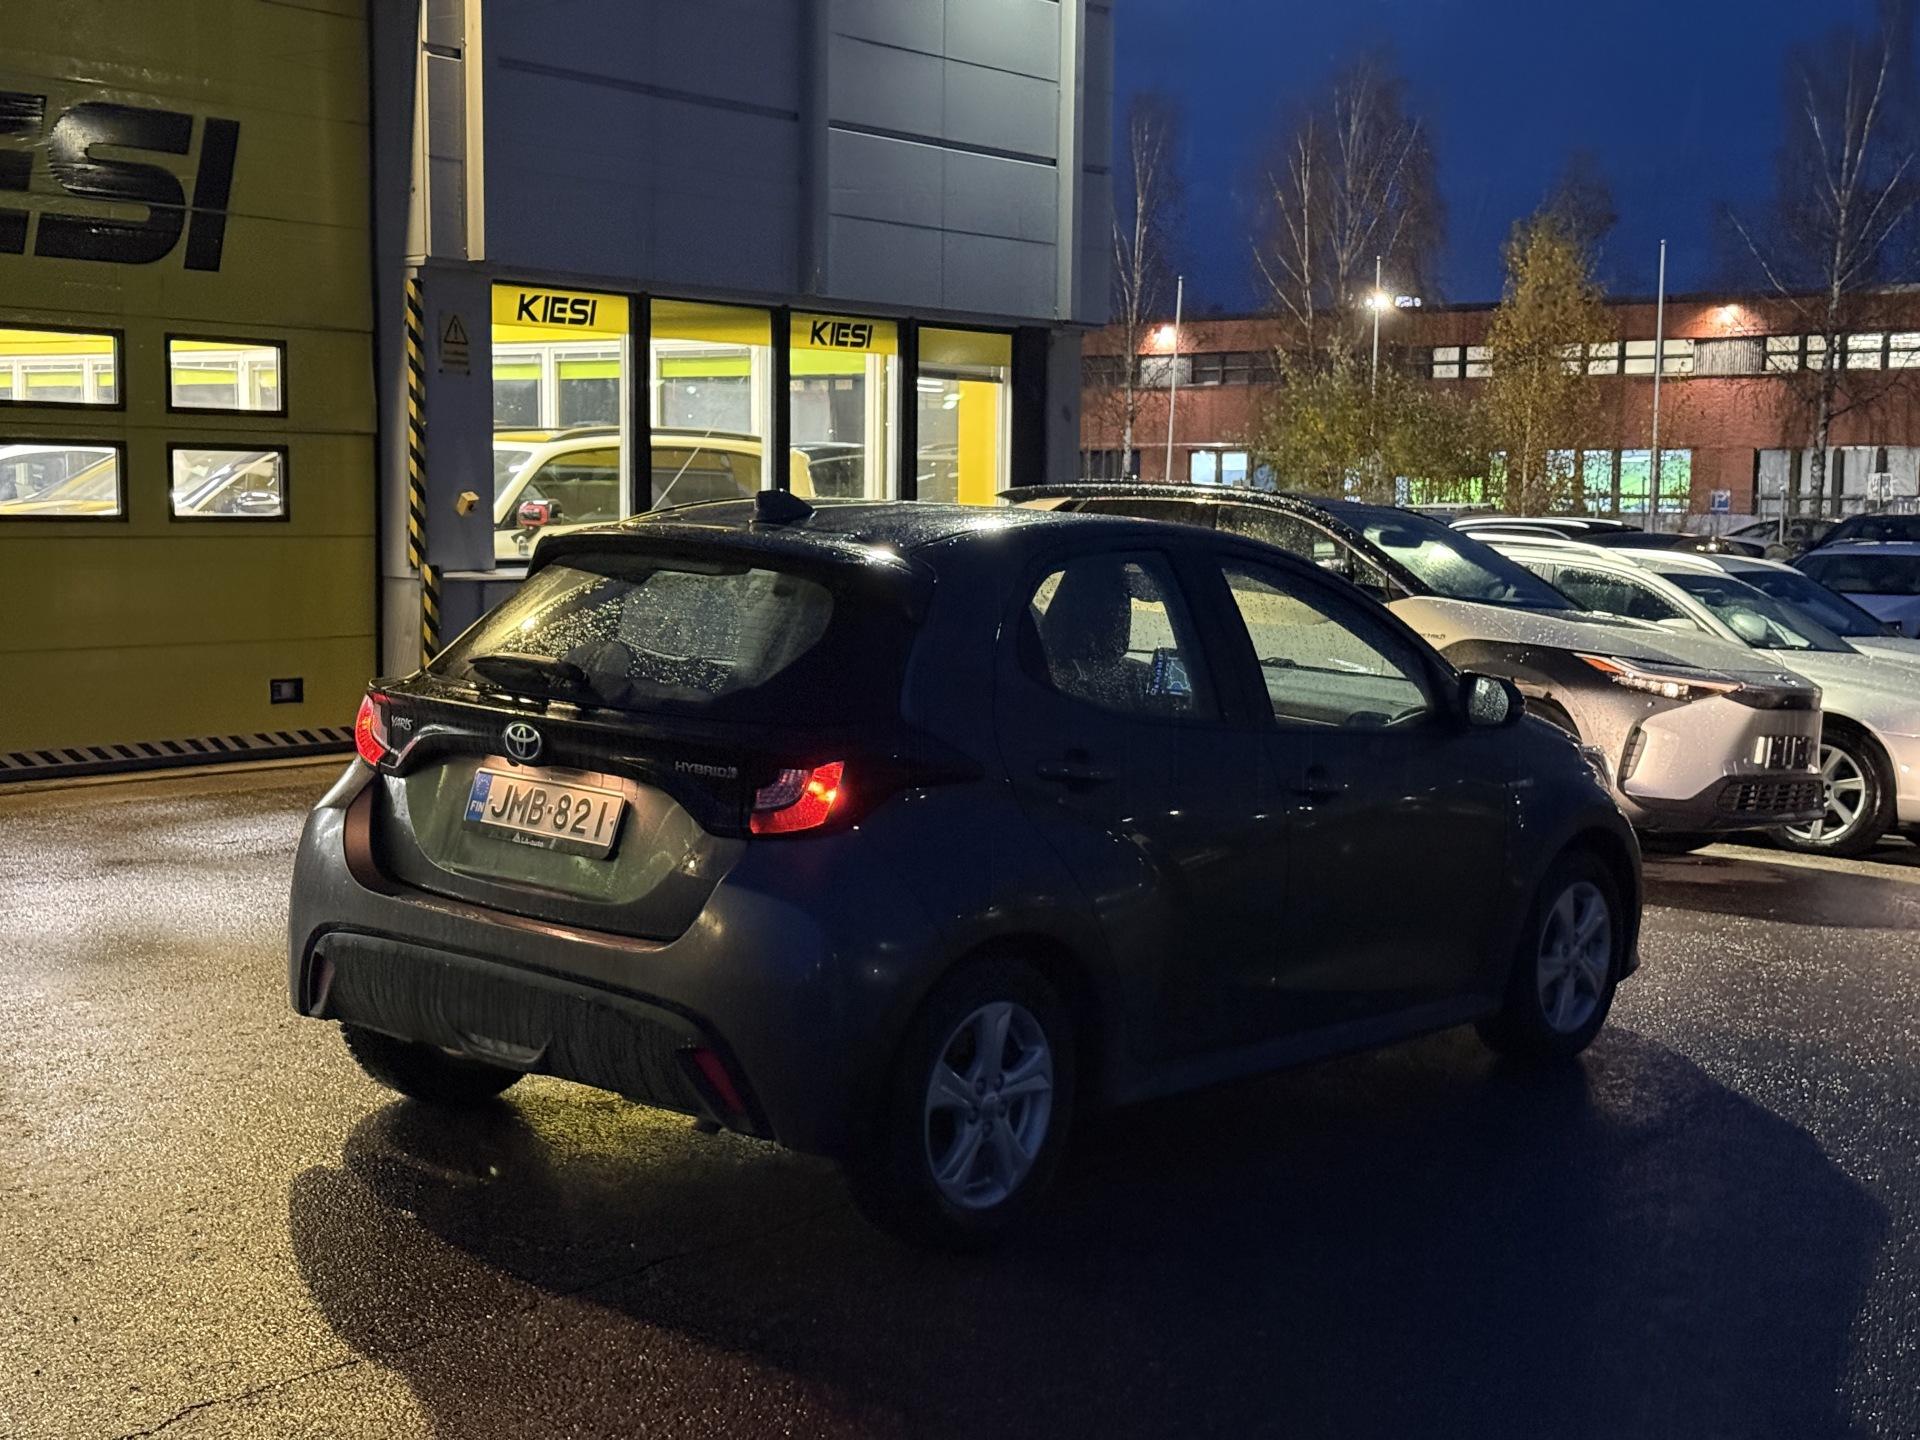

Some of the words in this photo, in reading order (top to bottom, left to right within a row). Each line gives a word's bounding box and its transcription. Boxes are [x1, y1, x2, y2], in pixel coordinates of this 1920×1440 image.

[517, 293, 597, 326] KIESI
[810, 321, 873, 349] KIESI
[391, 715, 413, 731] YARIS
[675, 760, 727, 778] HYBRID
[470, 799, 485, 813] FIN
[491, 784, 609, 838] JMB-821
